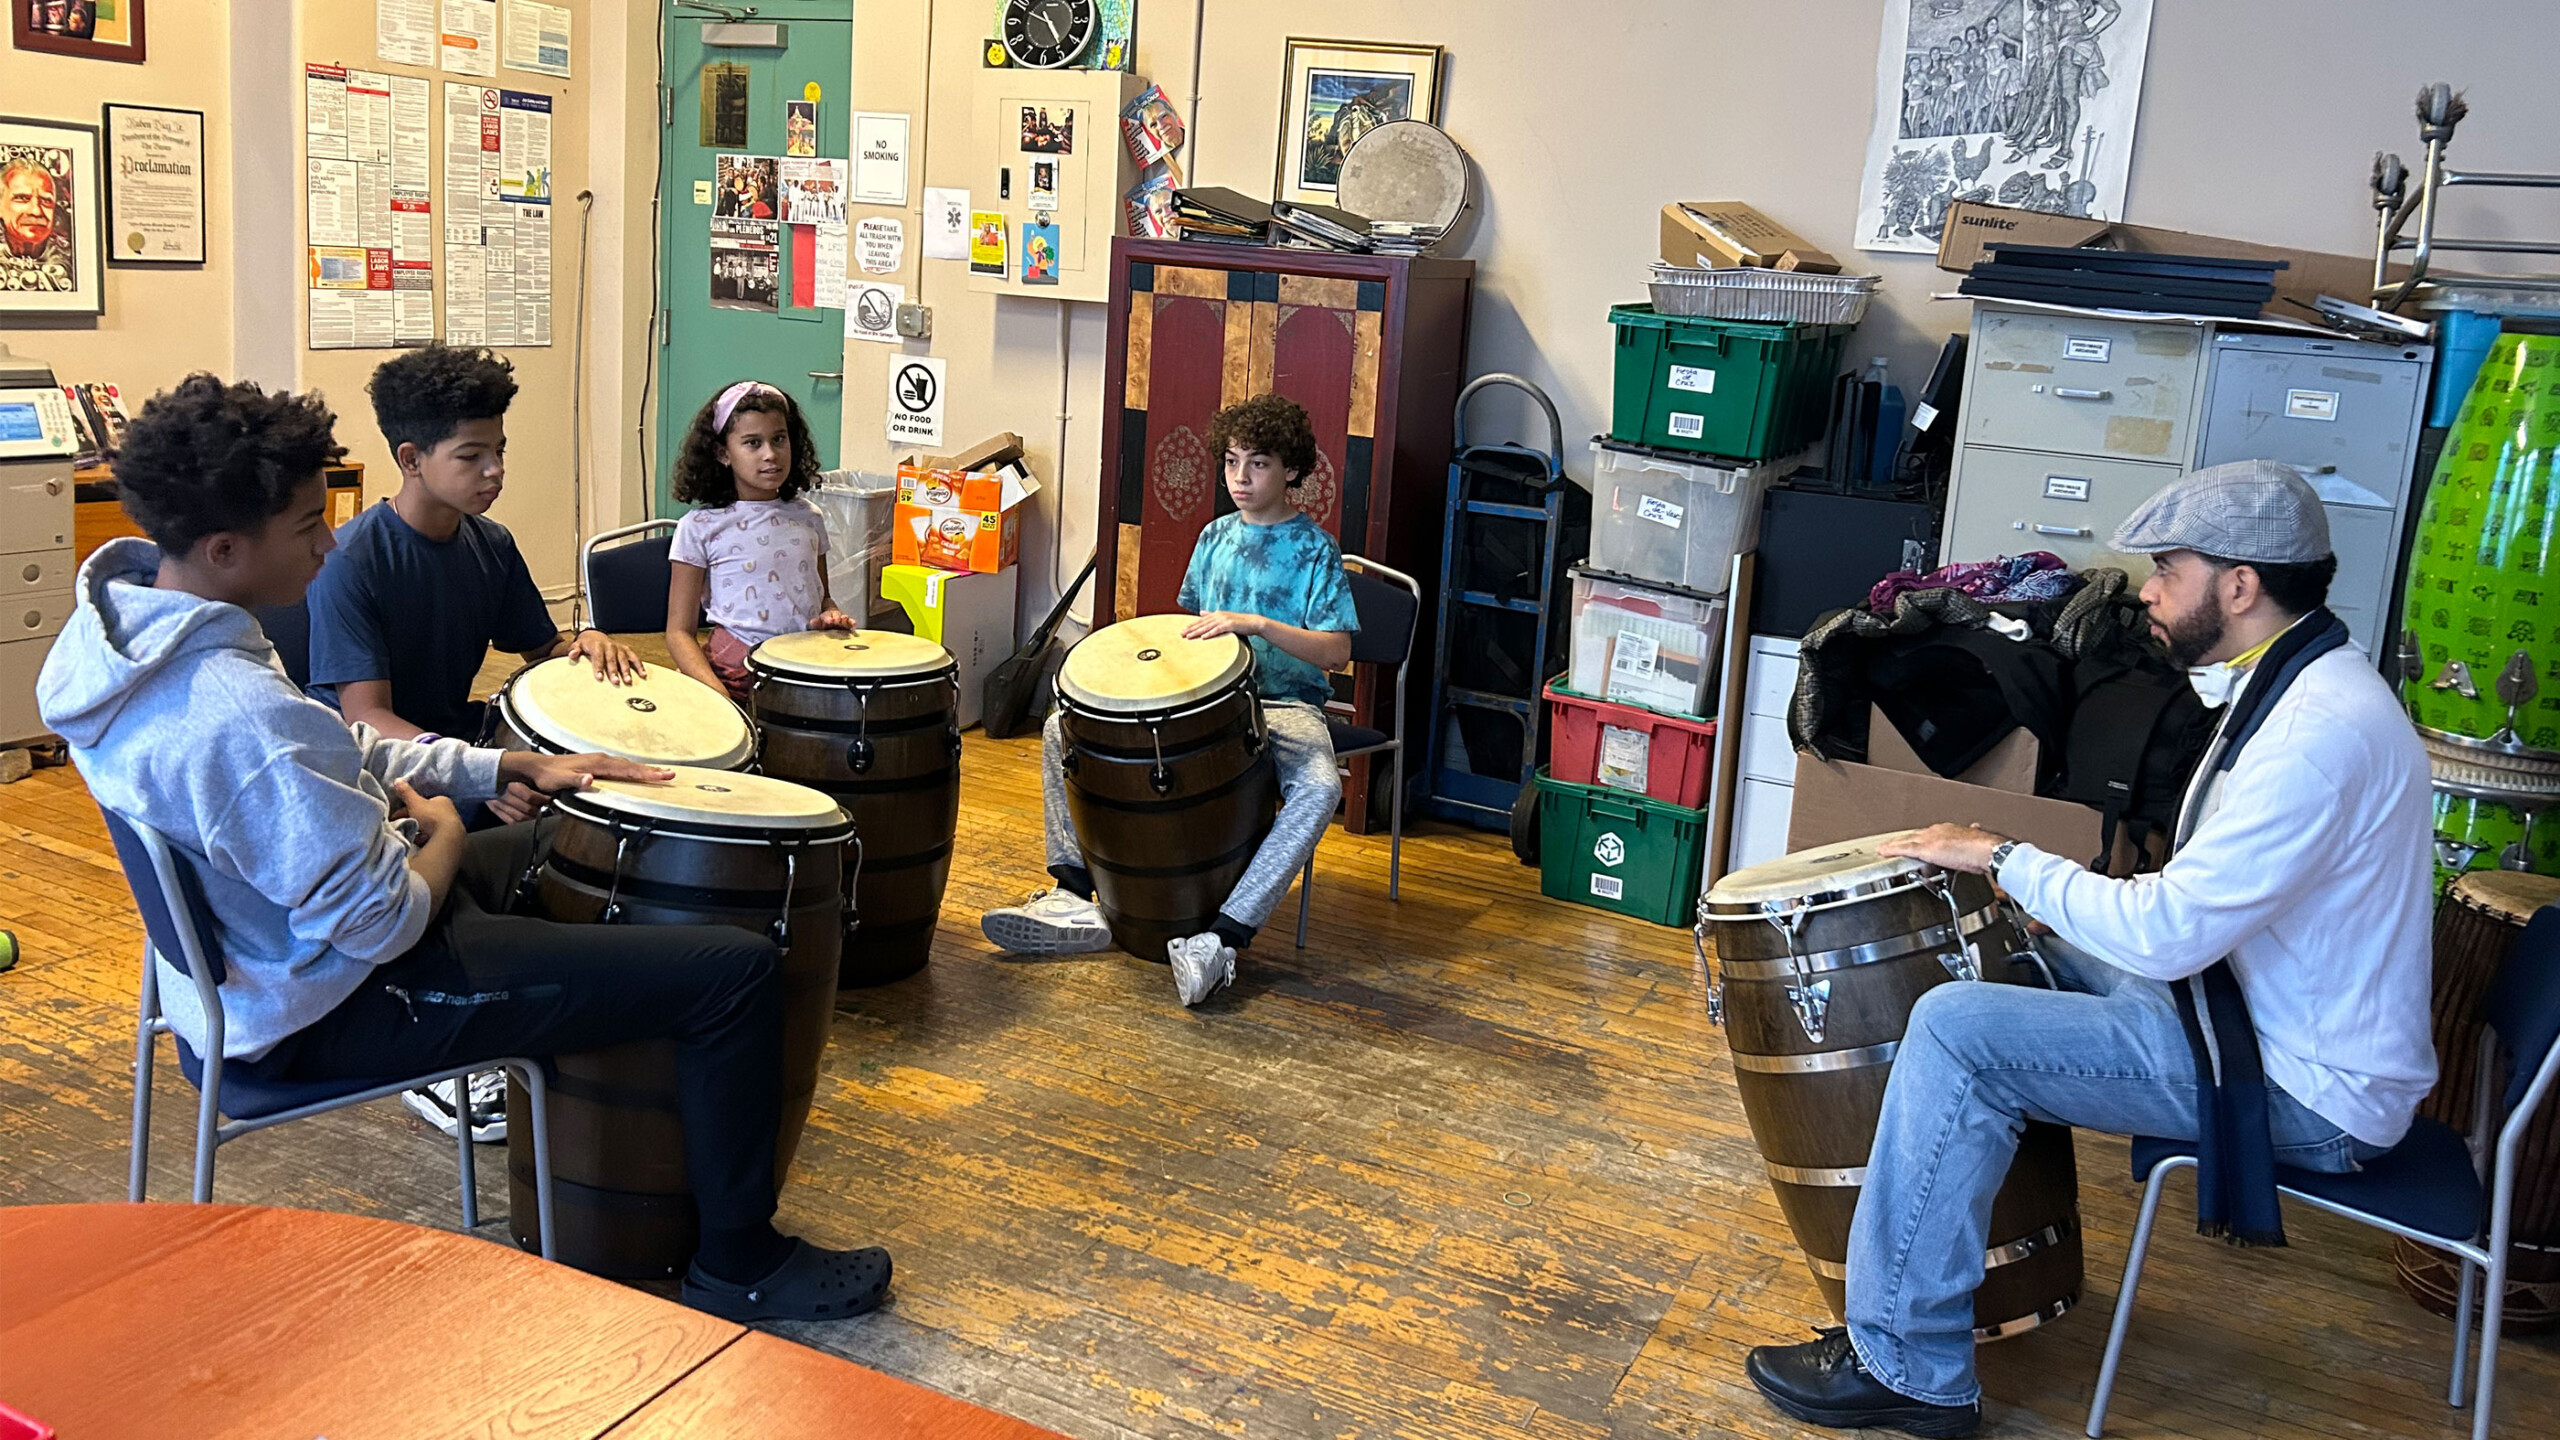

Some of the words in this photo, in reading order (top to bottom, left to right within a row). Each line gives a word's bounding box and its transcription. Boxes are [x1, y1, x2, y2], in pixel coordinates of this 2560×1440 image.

[1006, 18, 1022, 26] 9
[1074, 16, 1088, 24] 3
[1008, 34, 1024, 46] 8
[1068, 34, 1080, 44] 4
[1022, 44, 1034, 60] 7
[1055, 44, 1065, 60] 5
[1040, 49, 1047, 66] 6
[876, 140, 887, 149] NO
[864, 151, 899, 161] SMOKING
[120, 155, 191, 178] Proclamation
[523, 208, 532, 218] THE
[533, 210, 544, 218] LAW
[863, 223, 883, 231] PLEASE
[1961, 216, 2016, 230] sunlite
[770, 232, 777, 244] 21
[877, 242, 893, 250] WHEN
[868, 250, 890, 258] LEAVING
[894, 413, 908, 421] NO
[910, 414, 932, 424] FOOD
[892, 424, 906, 432] OR
[908, 426, 934, 436] DRINK
[982, 515, 996, 524] 45
[942, 522, 965, 532] Goldfish
